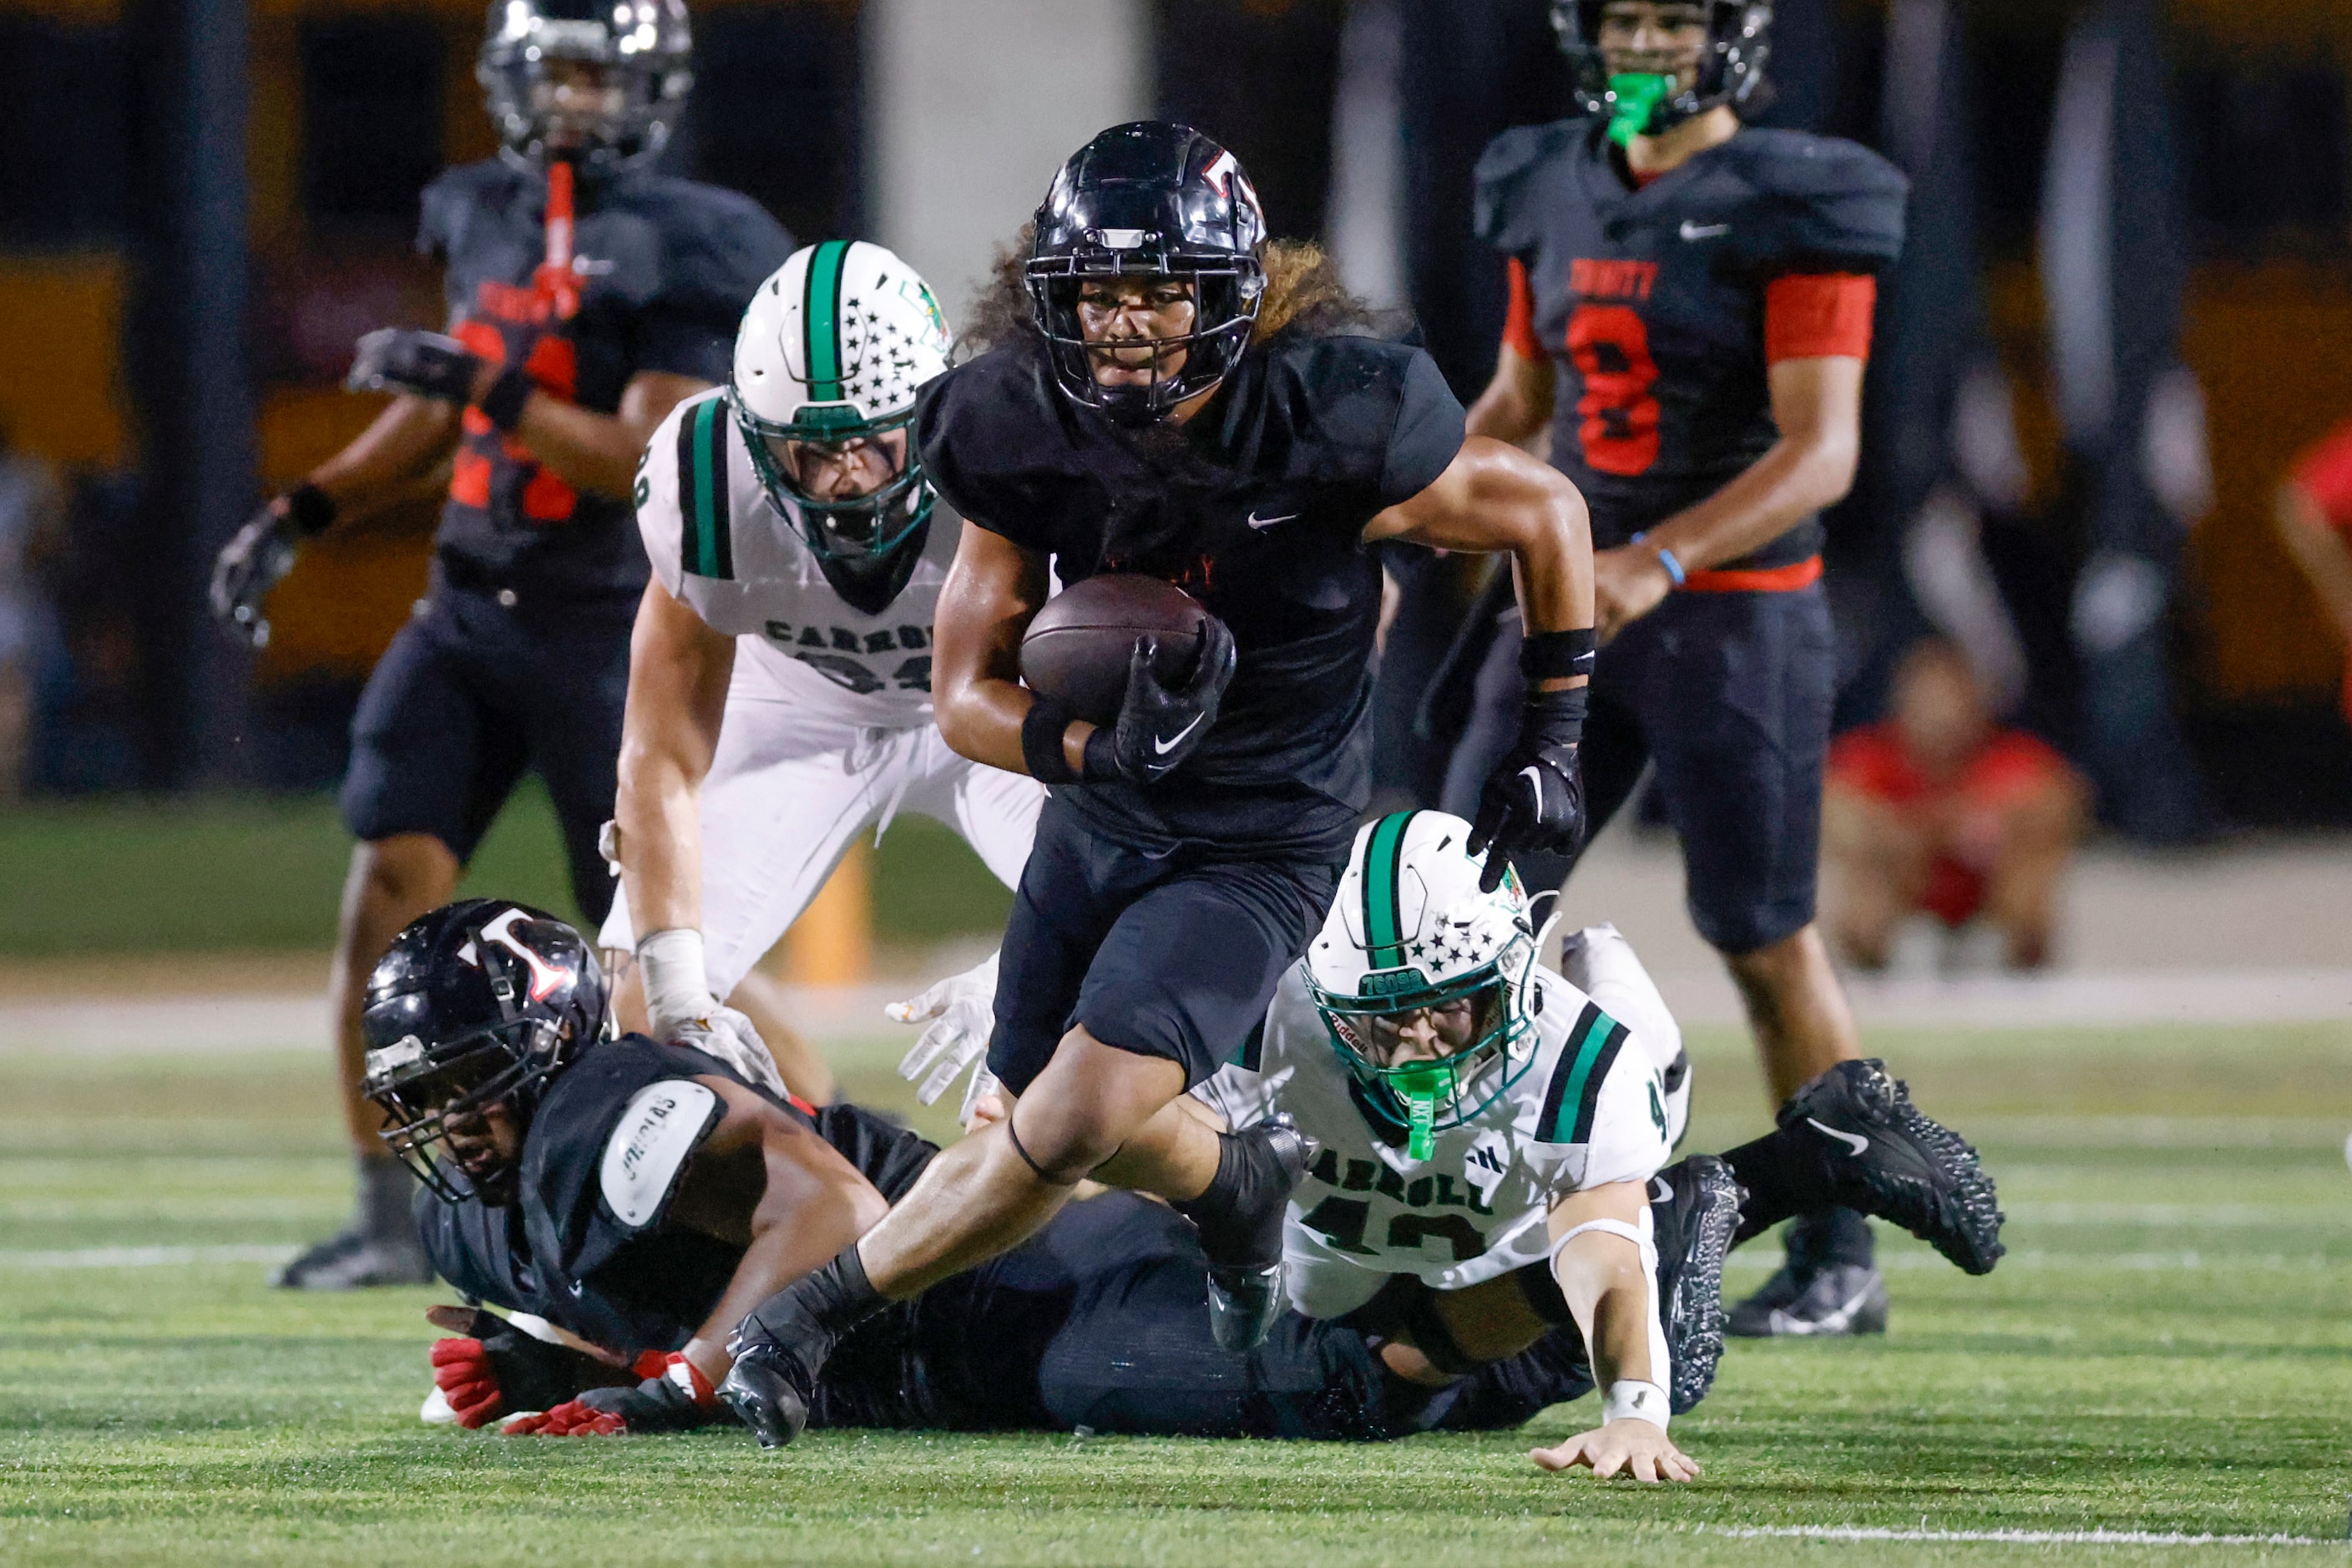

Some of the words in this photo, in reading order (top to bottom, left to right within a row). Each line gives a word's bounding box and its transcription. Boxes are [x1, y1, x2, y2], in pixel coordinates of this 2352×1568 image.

[1566, 304, 1661, 477] 8
[766, 618, 933, 655] CARRO
[1305, 1147, 1494, 1216] ARROLL
